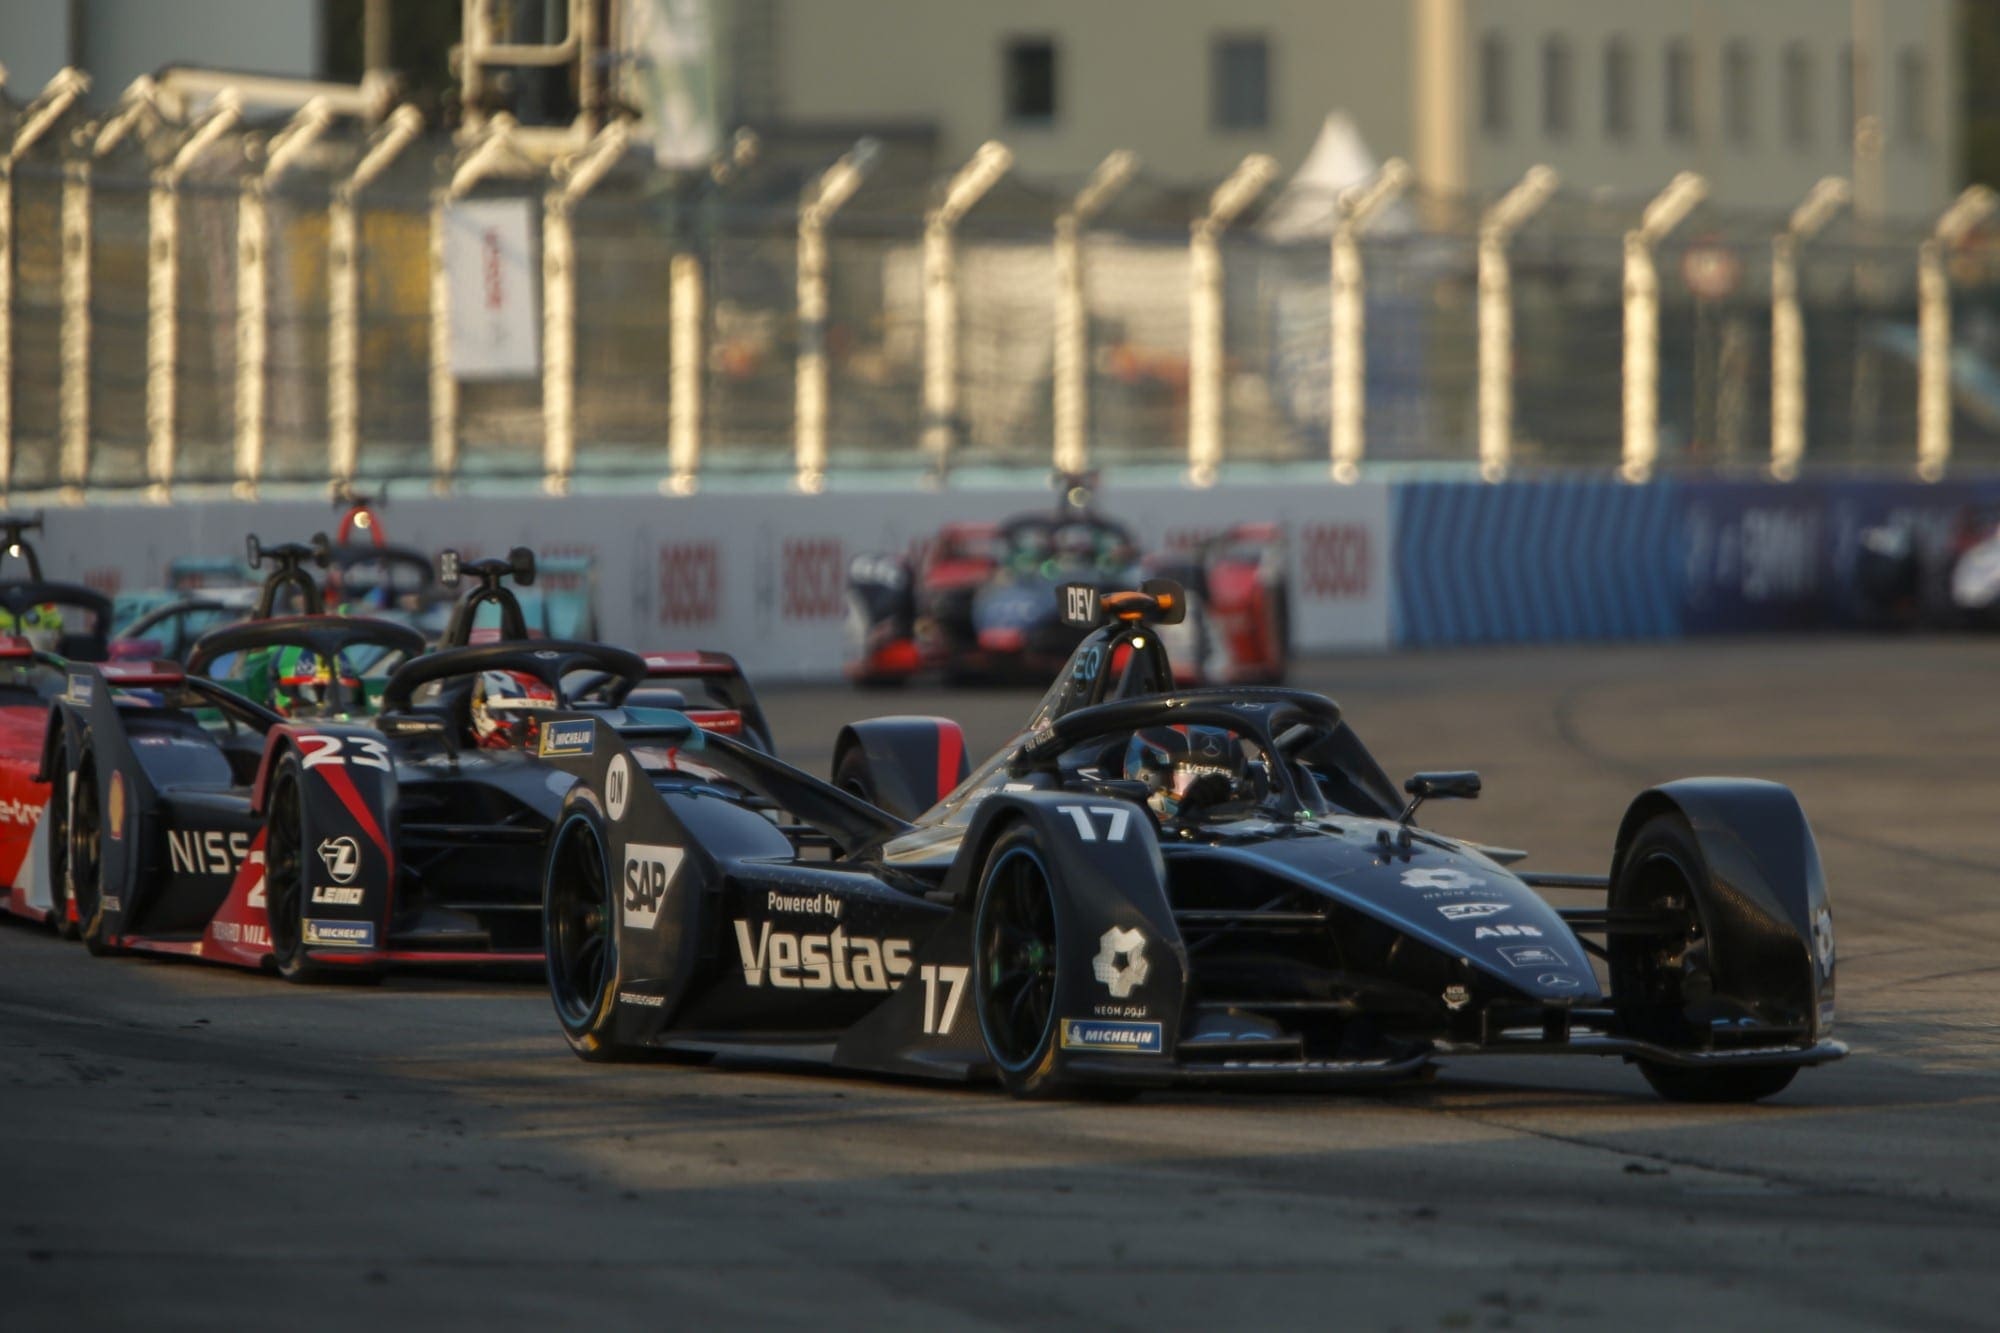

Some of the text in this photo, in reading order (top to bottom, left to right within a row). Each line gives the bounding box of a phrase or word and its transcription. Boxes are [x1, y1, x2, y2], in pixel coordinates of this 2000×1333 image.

[1067, 587, 1095, 622] DEV
[1072, 645, 1100, 680] EQ
[298, 735, 391, 772] 23
[555, 731, 592, 746] MICHELIN
[609, 770, 624, 804] ON
[1185, 762, 1232, 778] Vestas
[1056, 805, 1130, 841] 17
[311, 887, 365, 905] LEMO
[625, 858, 666, 914] SAP
[768, 891, 841, 918] Powered by
[318, 927, 368, 939] MICHELIN
[733, 919, 913, 990] Vestas
[920, 965, 969, 1035] 17
[1094, 1006, 1121, 1016] NEOM
[1085, 1030, 1153, 1044] MICHELIN
